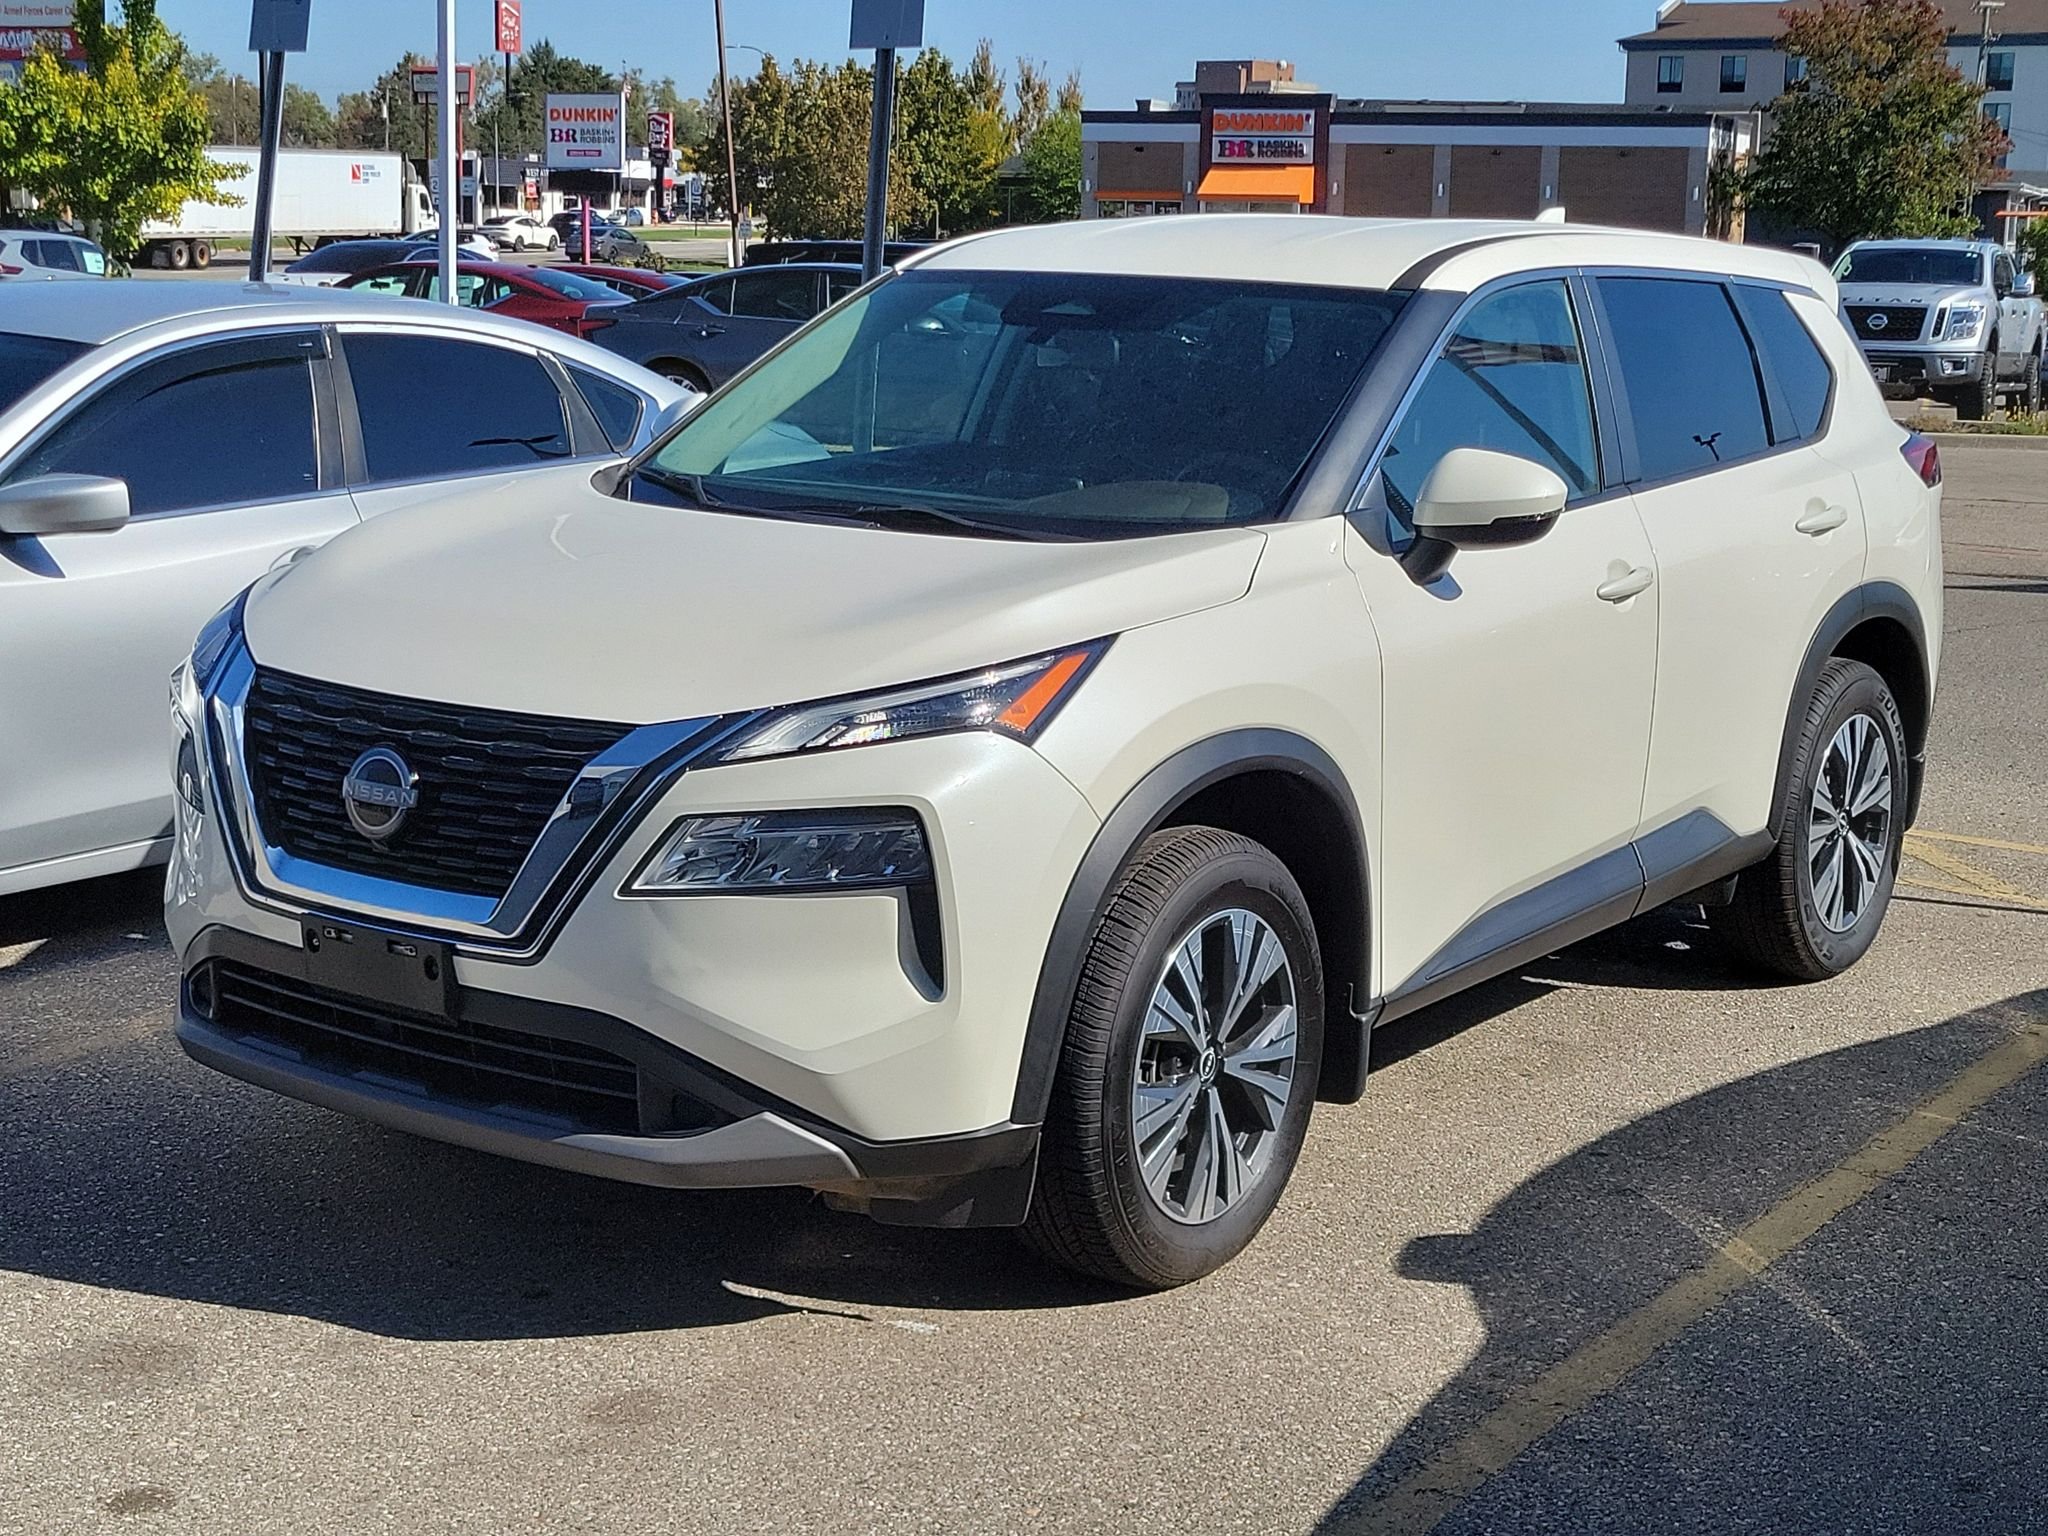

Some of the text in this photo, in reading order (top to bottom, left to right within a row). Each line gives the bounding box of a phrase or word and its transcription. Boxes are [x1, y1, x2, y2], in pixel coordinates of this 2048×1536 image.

[550, 108, 618, 122] DUNKIN'
[1214, 113, 1311, 131] DUNKIN'
[550, 128, 577, 143] BR
[580, 136, 615, 144] ROBBINS
[1218, 140, 1254, 157] BR
[1258, 149, 1304, 158] ROBBINS
[343, 777, 415, 805] NISSAN
